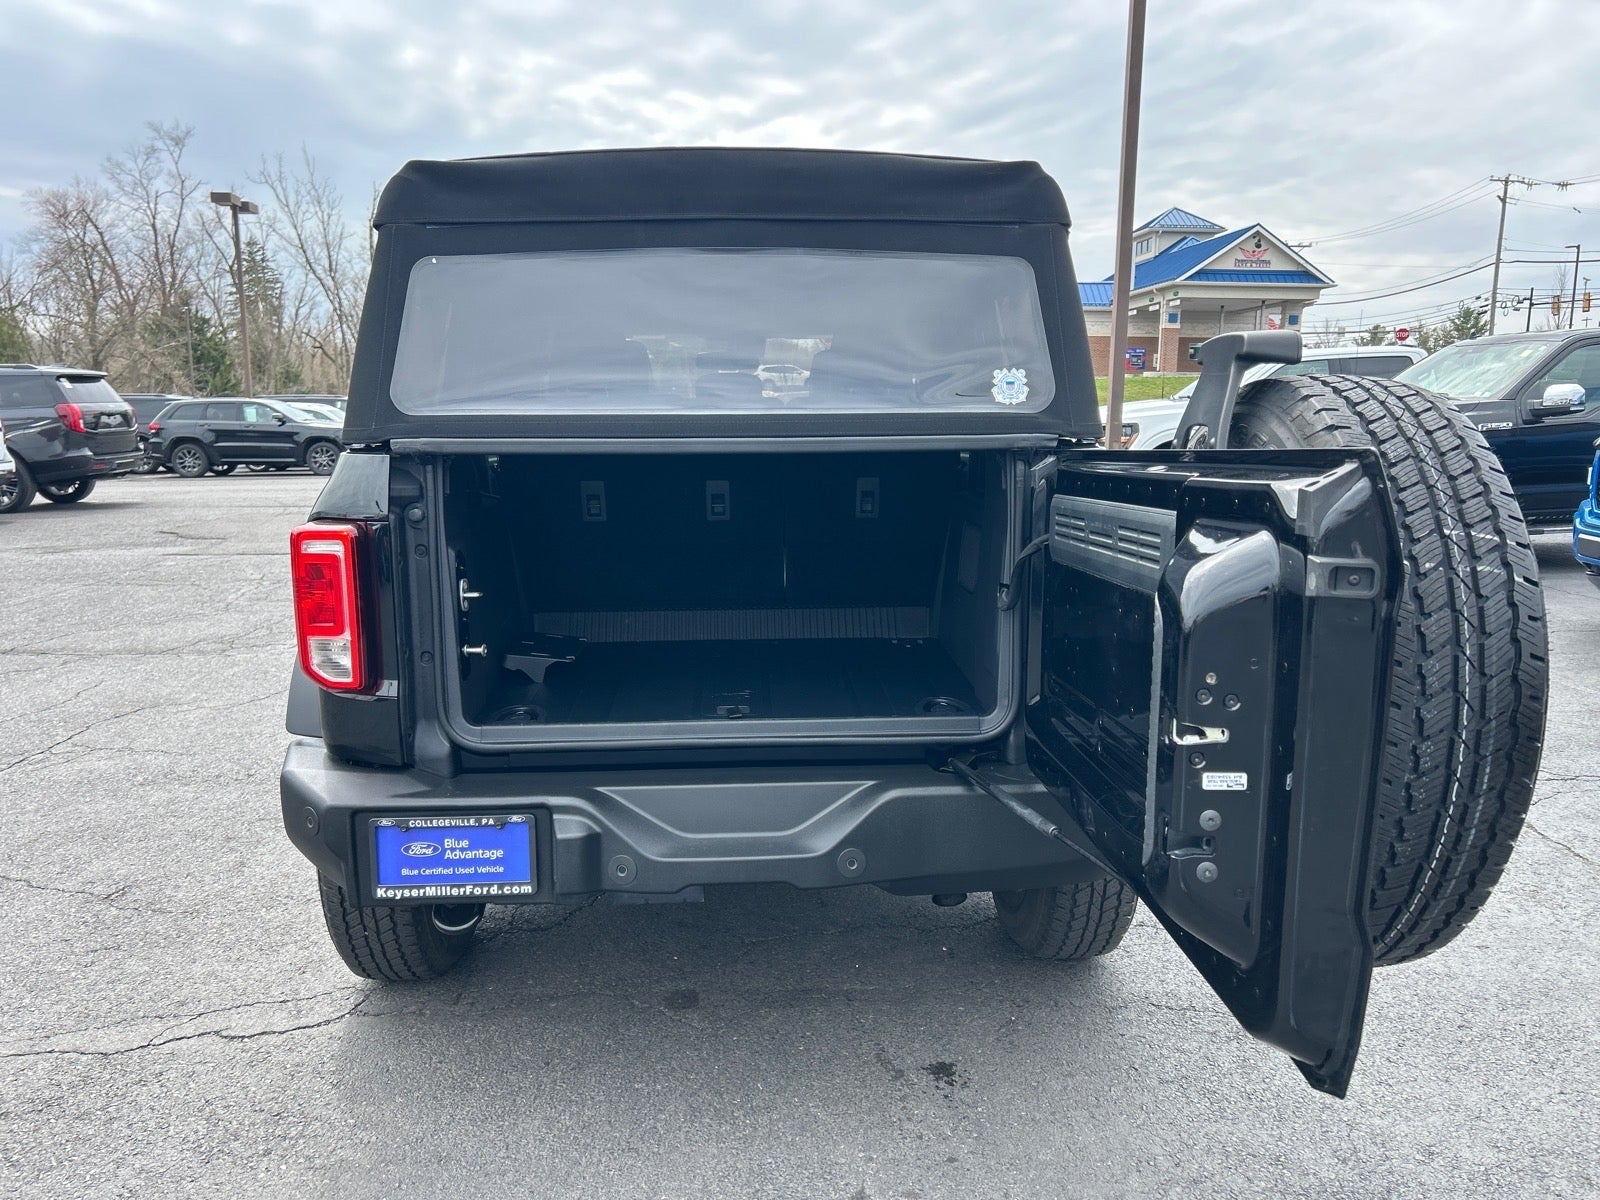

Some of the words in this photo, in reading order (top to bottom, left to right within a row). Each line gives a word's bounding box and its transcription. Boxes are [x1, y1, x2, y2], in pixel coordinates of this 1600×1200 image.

[409, 819, 479, 827] COLLEGEVILLE,
[444, 838, 469, 848] Blue
[444, 848, 504, 860] Advantage
[401, 868, 418, 876] Blue
[420, 867, 453, 875] Certified
[455, 866, 475, 874] Used
[476, 865, 504, 873] Vehicle
[376, 884, 532, 900] KeyserMillerFord.com
